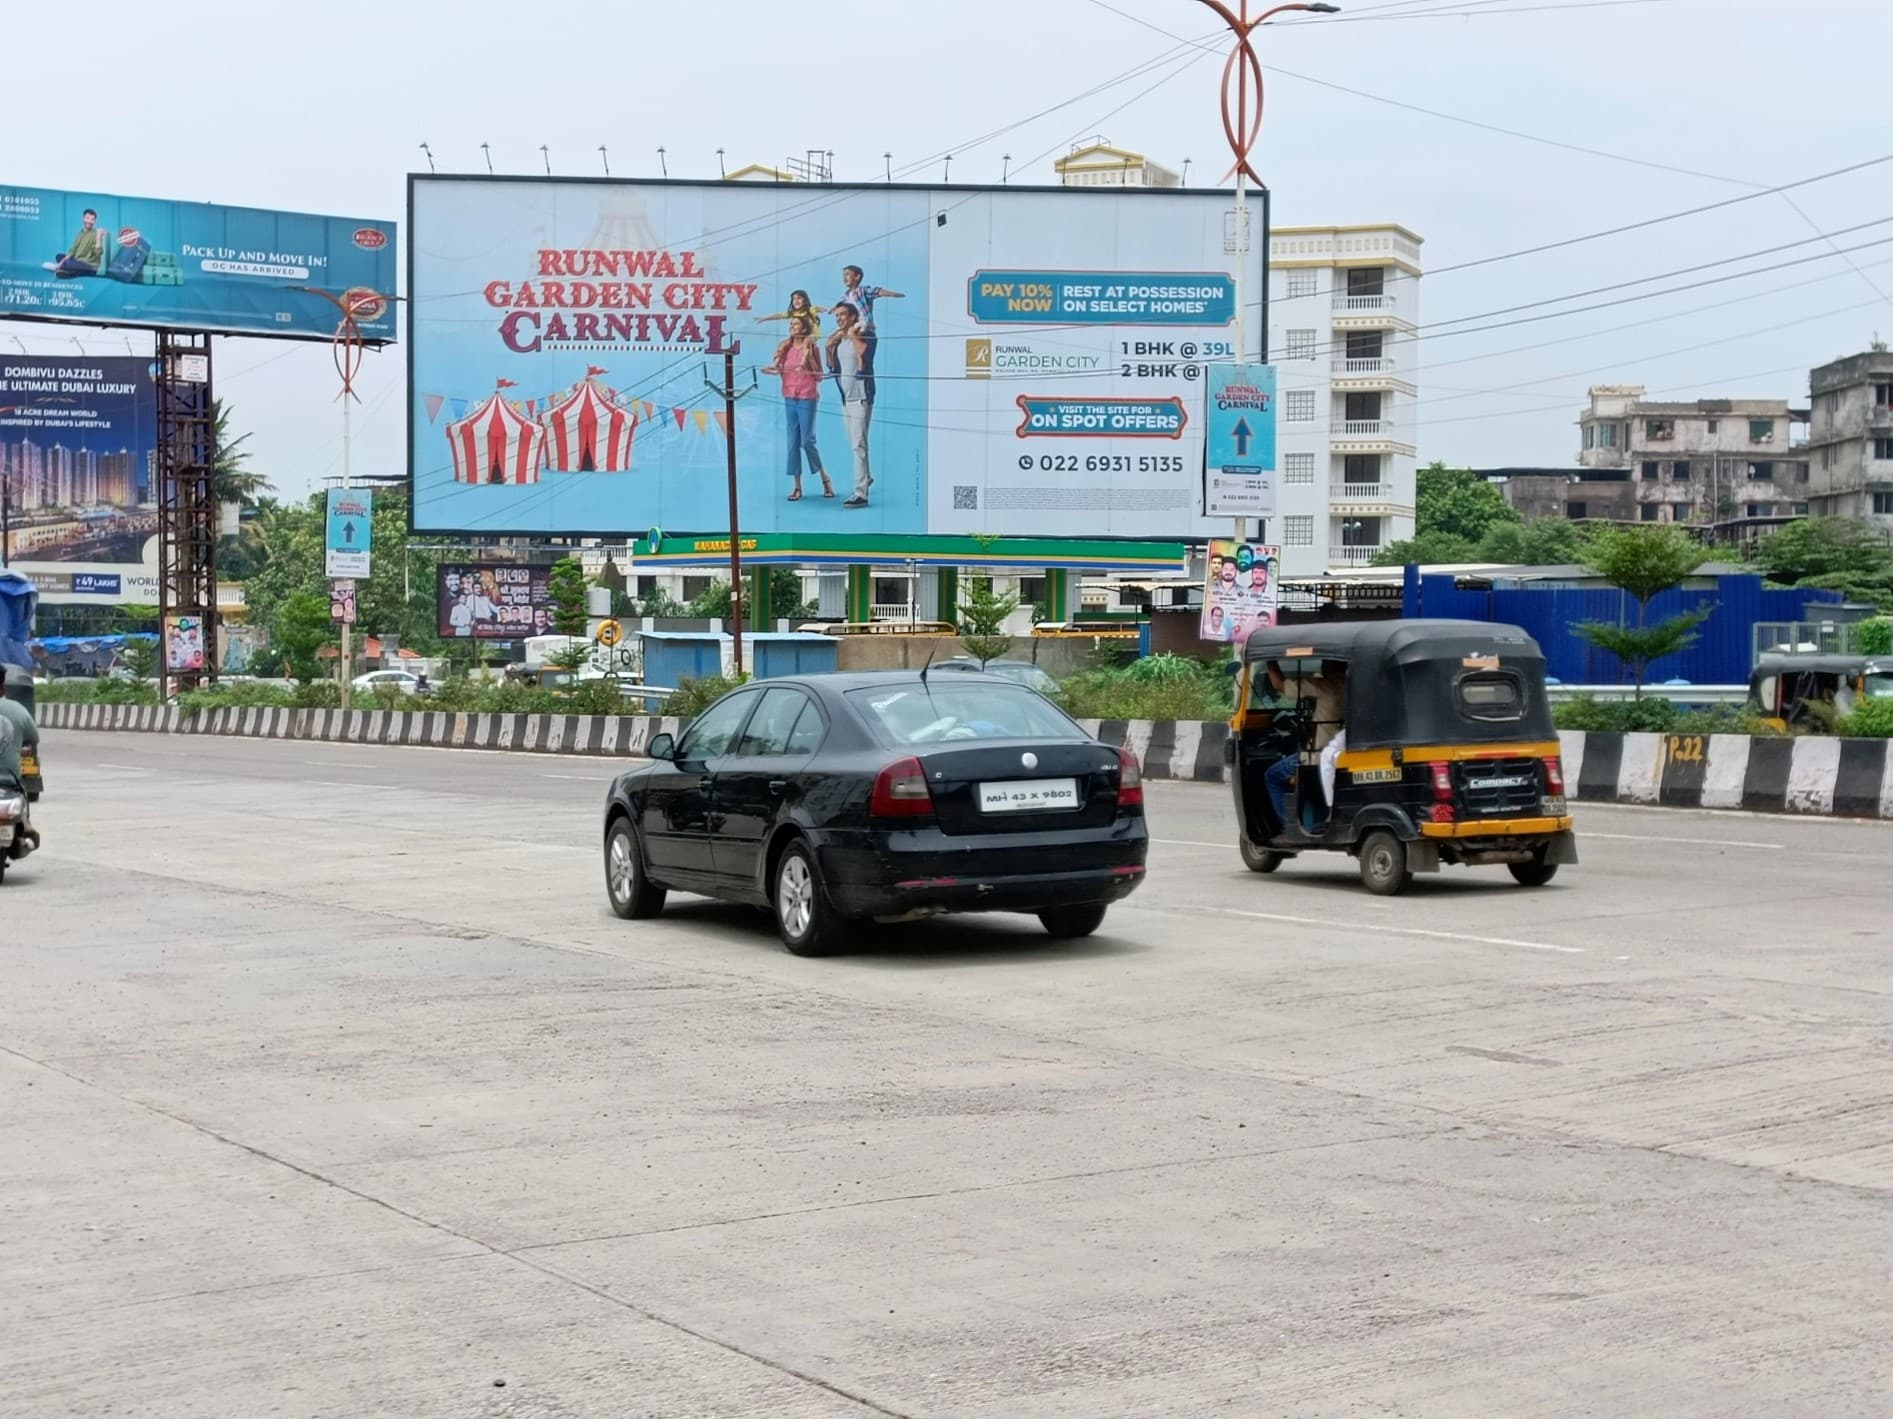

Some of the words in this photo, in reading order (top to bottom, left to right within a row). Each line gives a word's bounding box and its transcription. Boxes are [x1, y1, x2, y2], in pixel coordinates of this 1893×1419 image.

[182, 244, 215, 258] PACK
[218, 247, 236, 258] UP
[238, 250, 266, 262] AND
[268, 252, 305, 265] MOVE
[308, 255, 328, 268] IN!
[229, 263, 249, 271] HAS
[252, 266, 295, 275] ARRIVED
[537, 249, 704, 278] RUNWAL
[483, 281, 652, 308] GARDEN
[662, 283, 757, 310] CITY
[981, 284, 1014, 297] PAY
[1019, 284, 1053, 297] 10%
[1063, 285, 1102, 298] REST
[1105, 286, 1125, 298] AT
[1129, 287, 1223, 299] POSSESSION
[1008, 299, 1052, 312] NOW
[1063, 300, 1086, 312] ON
[1090, 301, 1147, 313] SELECT
[498, 311, 740, 354] CARNIVAL
[995, 345, 1032, 353] RUNWAL
[1121, 342, 1128, 355] 1
[1135, 342, 1174, 355] BHK
[1180, 342, 1198, 359] @
[995, 355, 1062, 367] GARDEN
[1066, 356, 1099, 368] CITY
[4, 366, 56, 378] DOMBIVLI
[58, 368, 103, 380] DAZZLES
[1121, 364, 1131, 377] 2
[1137, 364, 1176, 378] BHK
[1183, 364, 1200, 381] @
[11, 381, 58, 392] ULTIMATE
[61, 383, 94, 393] DUBAI
[96, 383, 137, 395] LUXURY
[22, 408, 42, 416] ACRE
[1058, 406, 1083, 414] VISIT
[1086, 406, 1105, 414] THE
[1217, 400, 1269, 412] CARNIVAL
[1031, 415, 1058, 427] ON
[1061, 415, 1107, 428] SPOT
[1111, 416, 1179, 428] OFFERS
[1040, 455, 1079, 471] 022
[1085, 455, 1131, 472] 6931
[1138, 456, 1183, 472] 5135
[740, 539, 757, 550] GAS
[81, 575, 94, 586] 49
[987, 792, 1008, 802] MH
[1043, 789, 1073, 799] 9802
